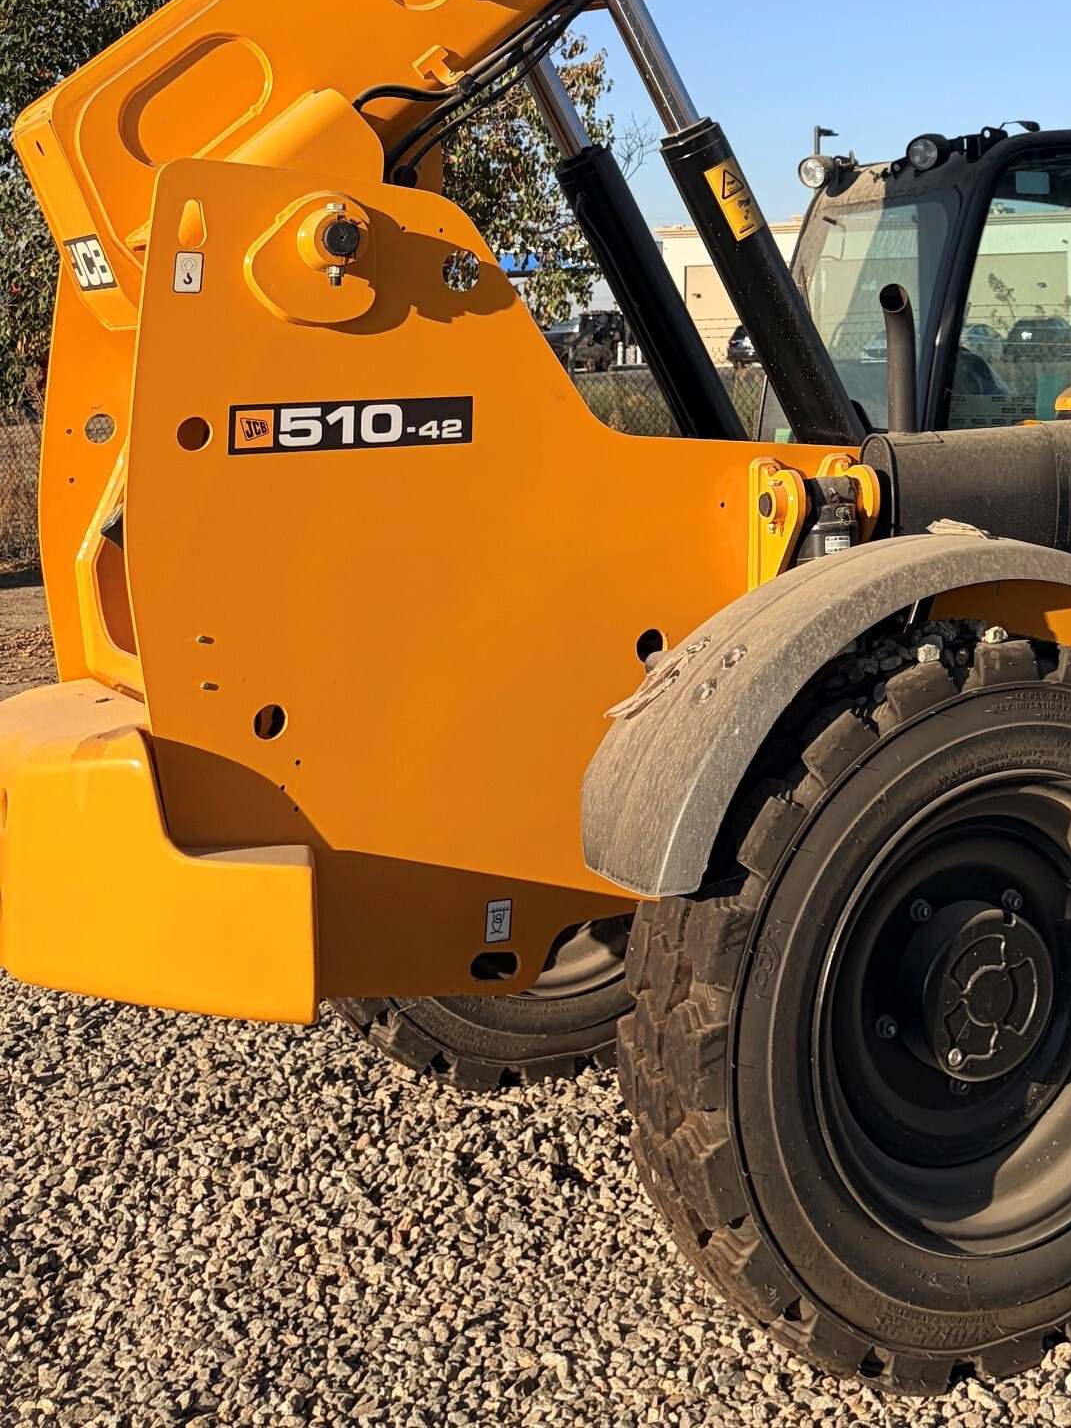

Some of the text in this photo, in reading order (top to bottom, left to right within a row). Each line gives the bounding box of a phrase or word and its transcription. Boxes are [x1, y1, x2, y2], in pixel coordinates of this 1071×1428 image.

[71, 239, 114, 287] JCB
[245, 419, 268, 438] JCB
[278, 404, 463, 447] 510-42
